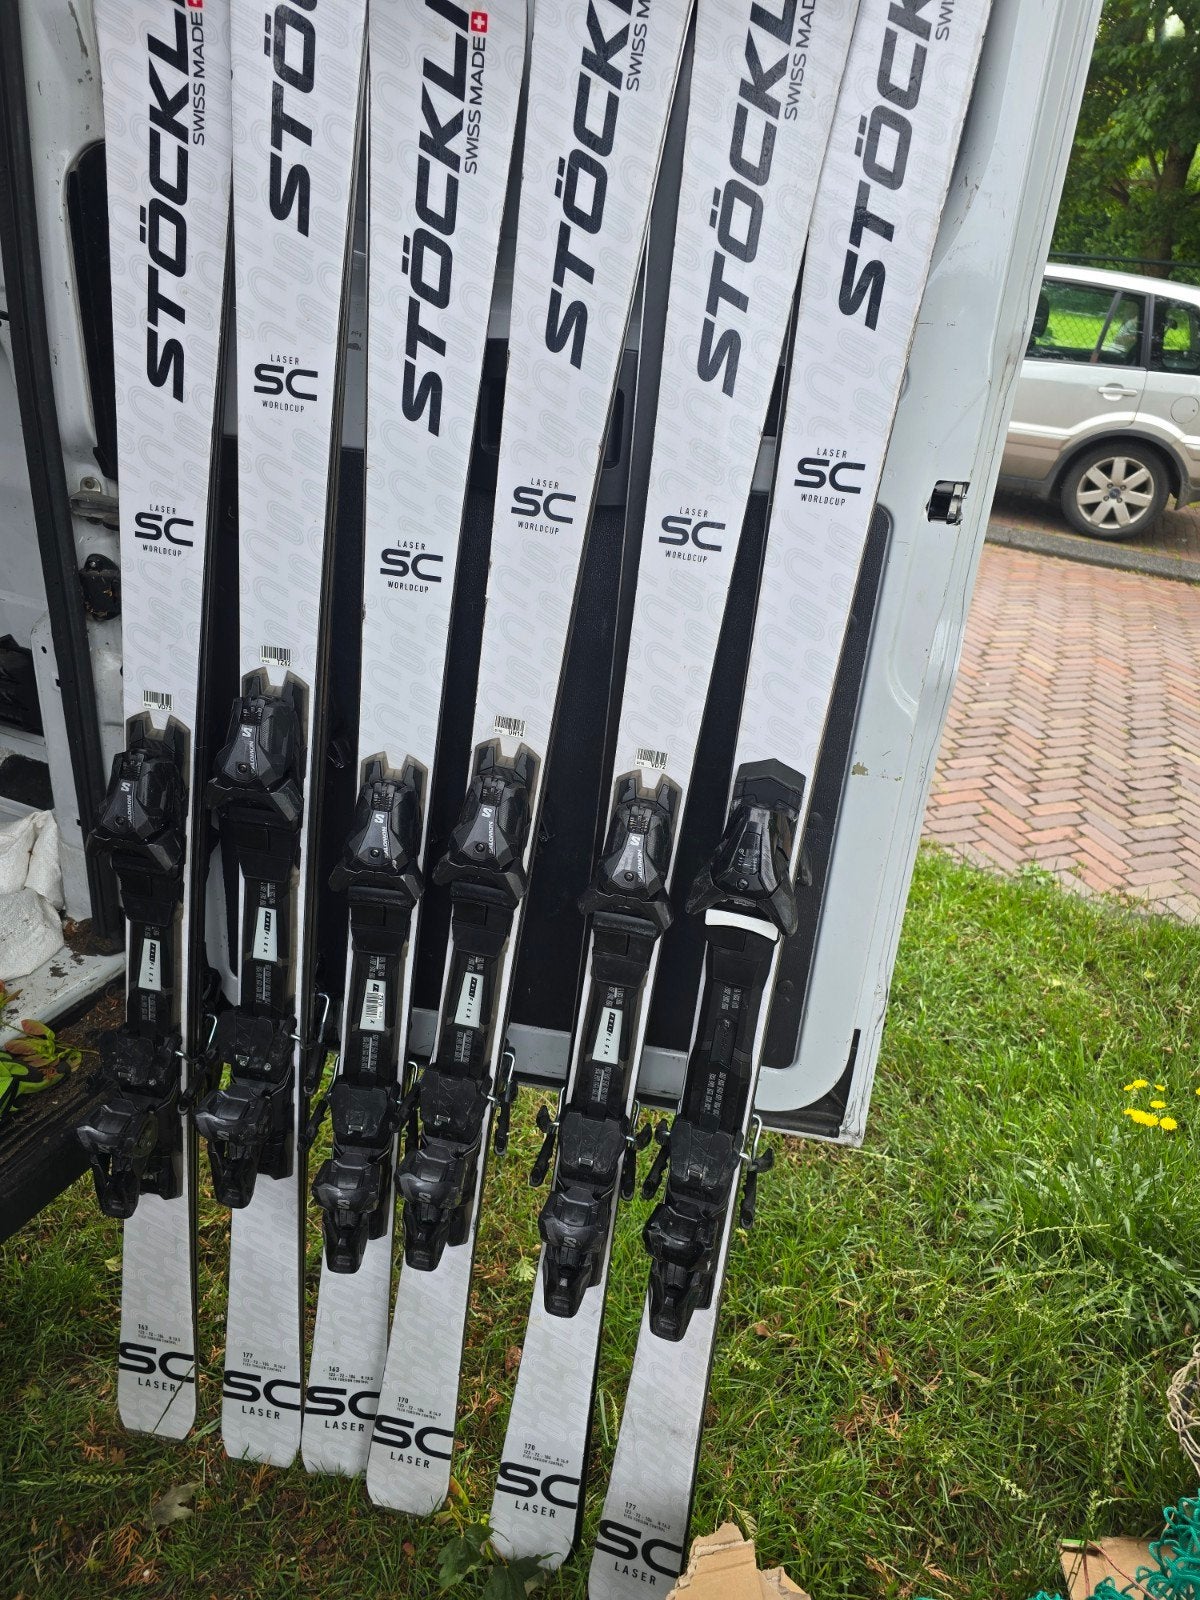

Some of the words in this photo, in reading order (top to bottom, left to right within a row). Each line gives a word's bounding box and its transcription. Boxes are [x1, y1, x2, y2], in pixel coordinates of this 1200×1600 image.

[190, 11, 205, 79] MADE
[626, 23, 648, 92] SWISS
[471, 36, 486, 106] MADE
[783, 53, 807, 121] SWISS
[192, 82, 205, 146] SWISS
[264, 0, 318, 238] STÖ
[464, 109, 482, 175] SWISS
[140, 0, 190, 403] STÖCKL
[545, 0, 634, 370] STÖCK
[401, 0, 470, 438] STÖCKLI
[270, 354, 300, 366] LASER
[254, 363, 318, 402] SC
[261, 400, 305, 413] WORLDCUP
[816, 447, 848, 459] LASER
[530, 477, 560, 490] LASER
[794, 457, 866, 494] SC
[149, 504, 177, 515] LASER
[511, 486, 577, 525] SC
[679, 506, 709, 518] LASER
[800, 493, 846, 506] WORLDCUP
[134, 512, 194, 547] SC
[517, 520, 560, 535] WORLDCUP
[658, 515, 726, 552] SC
[142, 544, 182, 557] WORLDCUP
[397, 540, 426, 551] LASER
[665, 550, 708, 564] WORLDCUP
[380, 548, 444, 584] SC
[387, 580, 430, 594] WORLDCUP
[118, 1342, 194, 1383] SC
[138, 1377, 176, 1392] LASER
[222, 1370, 300, 1411] SC
[398, 1396, 408, 1404] 170
[242, 1405, 280, 1420] LASER
[305, 1386, 380, 1420] SC
[324, 1420, 364, 1432] LASER
[372, 1414, 454, 1460] SC
[390, 1452, 430, 1468] LASER
[496, 1462, 580, 1510] SC
[514, 1500, 556, 1518] LASER
[625, 1502, 636, 1510] 177
[595, 1520, 684, 1578] SC
[614, 1562, 656, 1586] LASER
